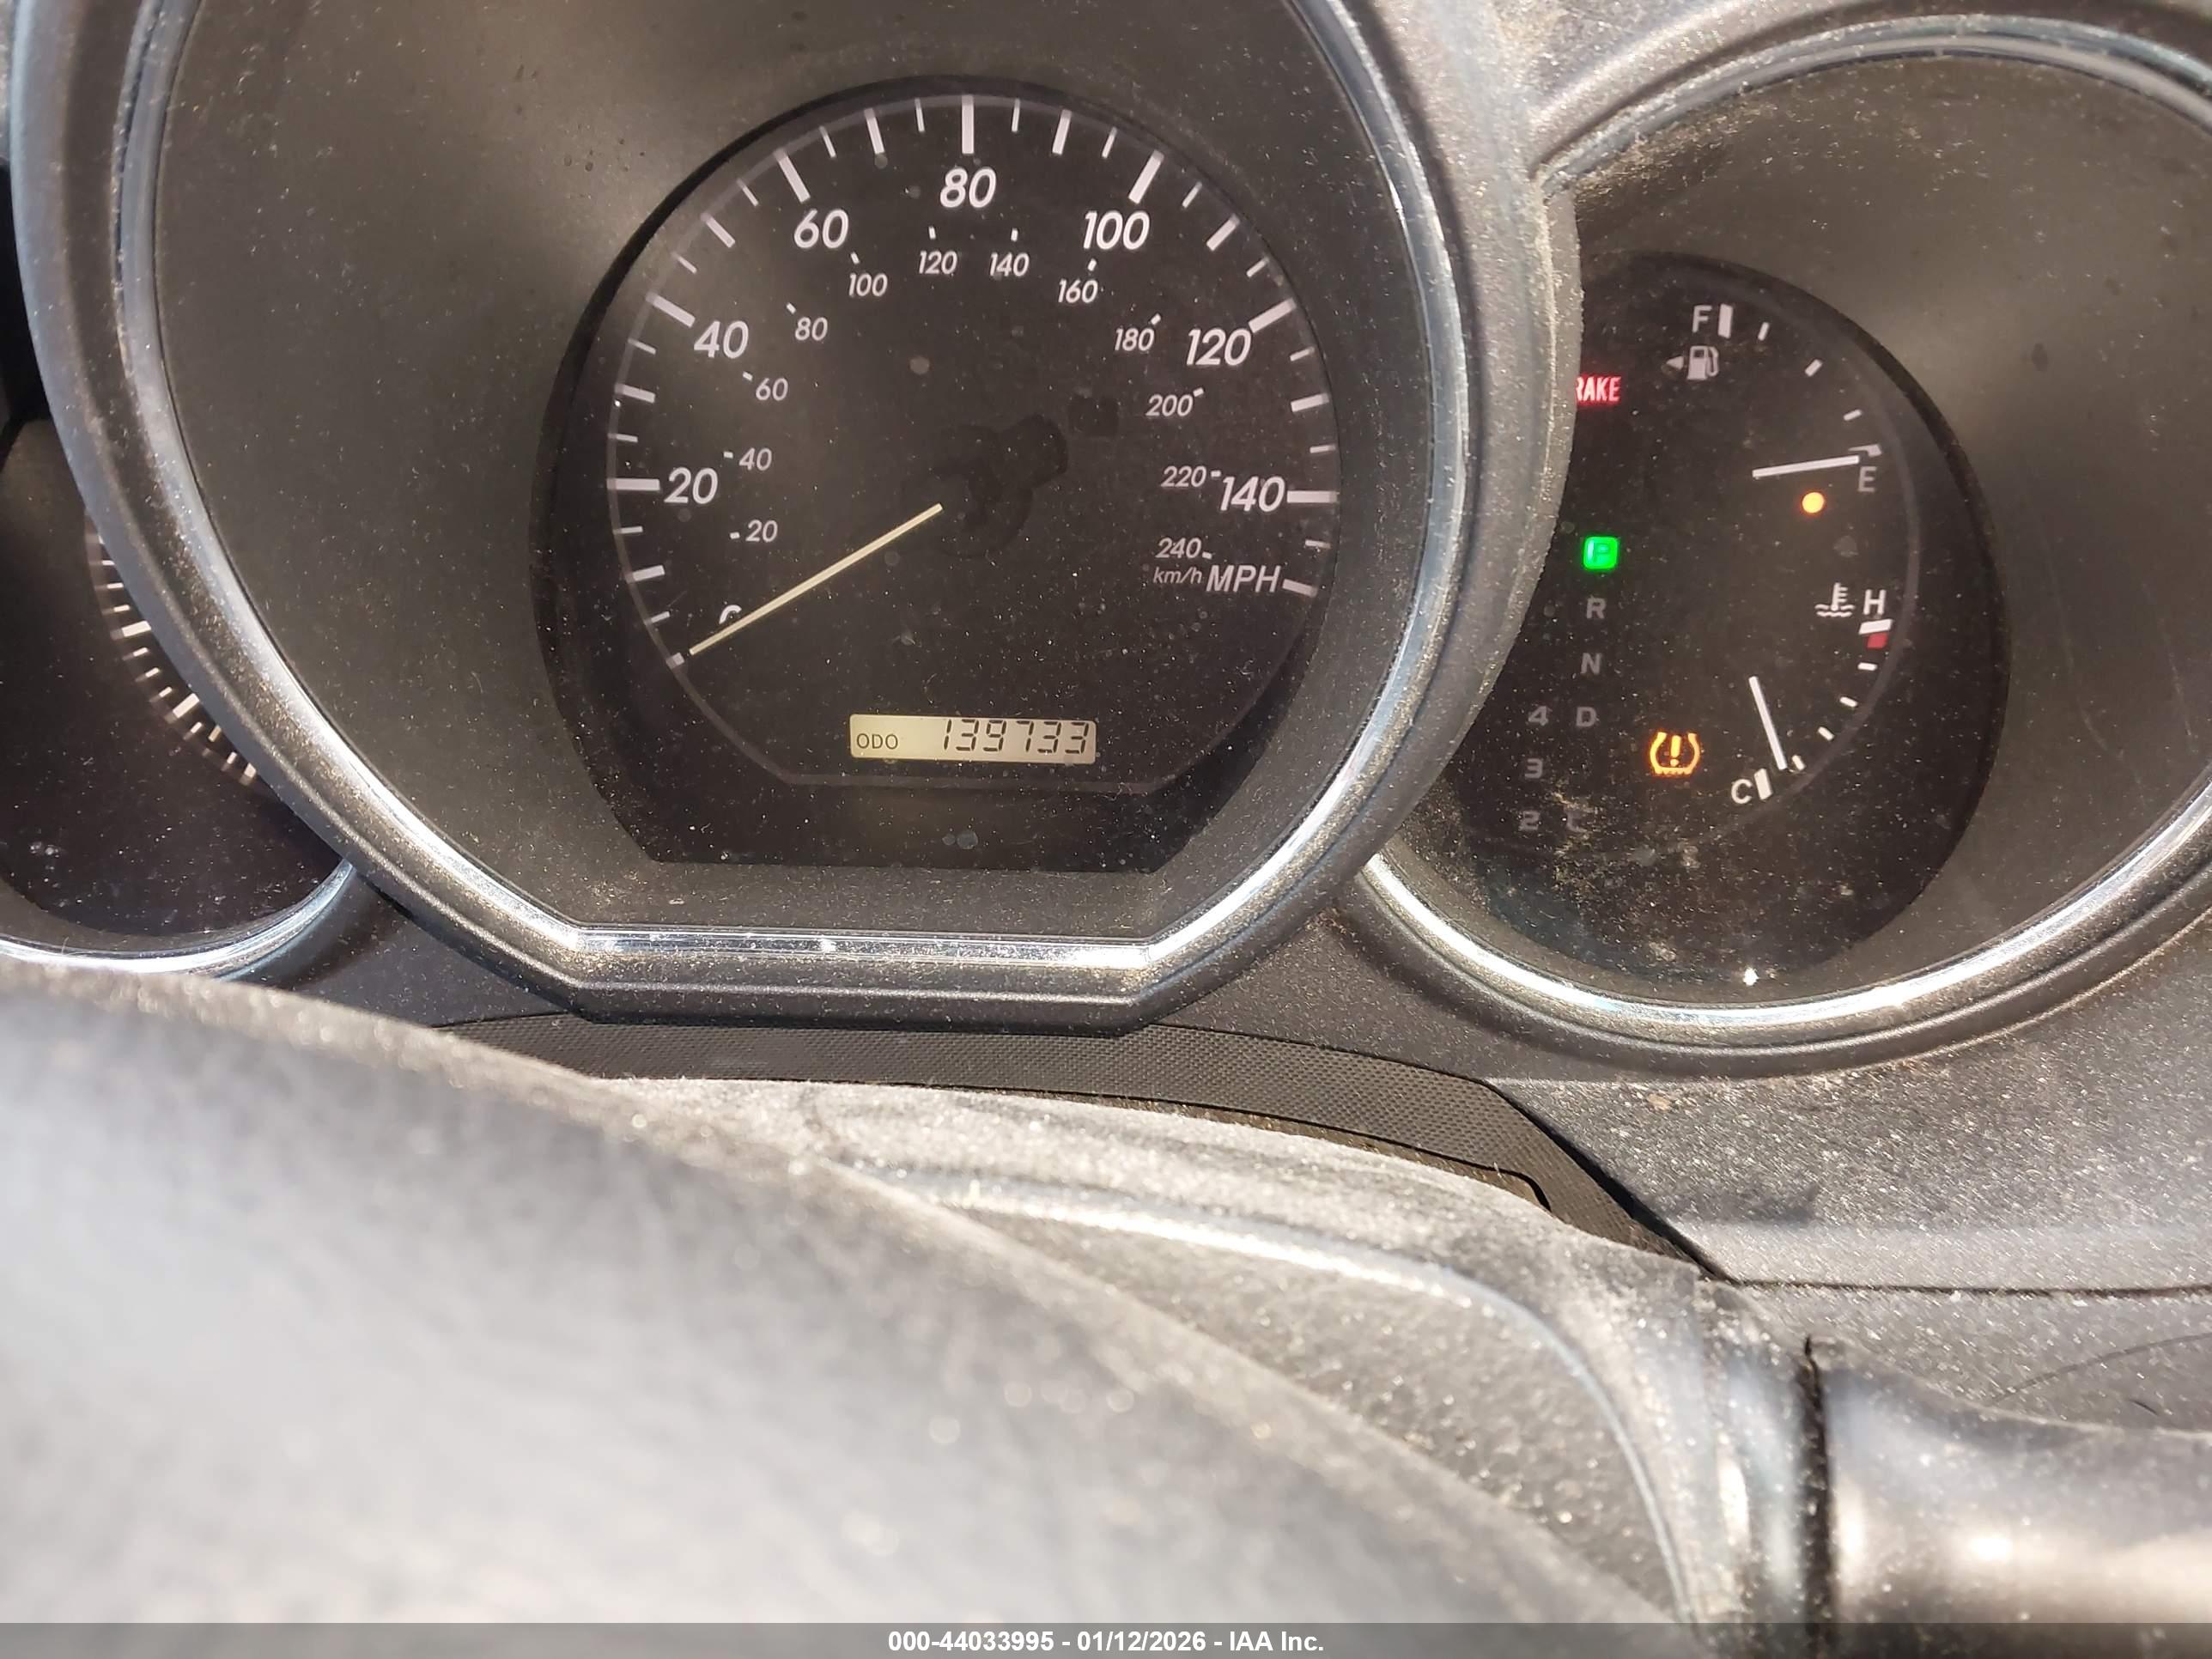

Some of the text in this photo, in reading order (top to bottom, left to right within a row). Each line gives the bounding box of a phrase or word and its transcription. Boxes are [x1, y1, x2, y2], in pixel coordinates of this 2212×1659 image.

[939, 167, 997, 209] 80
[793, 209, 849, 249] 60
[1083, 210, 1150, 251] 100
[919, 250, 958, 275] 120
[989, 252, 1030, 277] 140
[848, 273, 888, 297] 100
[1058, 279, 1098, 304] 160
[794, 316, 829, 342] 80
[1692, 305, 1713, 333] F
[693, 320, 749, 359] 40
[1115, 327, 1155, 352] 180
[1186, 327, 1252, 367] 120
[755, 377, 788, 402] 60
[1575, 375, 1622, 402] RAKE
[1146, 394, 1194, 417] 200
[738, 447, 772, 471] 40
[664, 466, 719, 505] 20
[1160, 465, 1207, 488] 220
[1857, 465, 1877, 493] E
[1220, 476, 1285, 513] 140
[745, 519, 778, 544] 20
[1155, 537, 1202, 559] 240
[1152, 566, 1203, 585] km/h
[1206, 564, 1281, 593] MPH
[1585, 597, 1607, 620] R
[1863, 589, 1887, 616] H
[1580, 652, 1602, 675] N
[1528, 705, 1549, 726] 4
[1576, 706, 1599, 728] D
[856, 717, 1091, 755] ODO 139733
[1524, 757, 1544, 779] 3
[1730, 778, 1753, 805] C
[1518, 810, 1540, 831] 2
